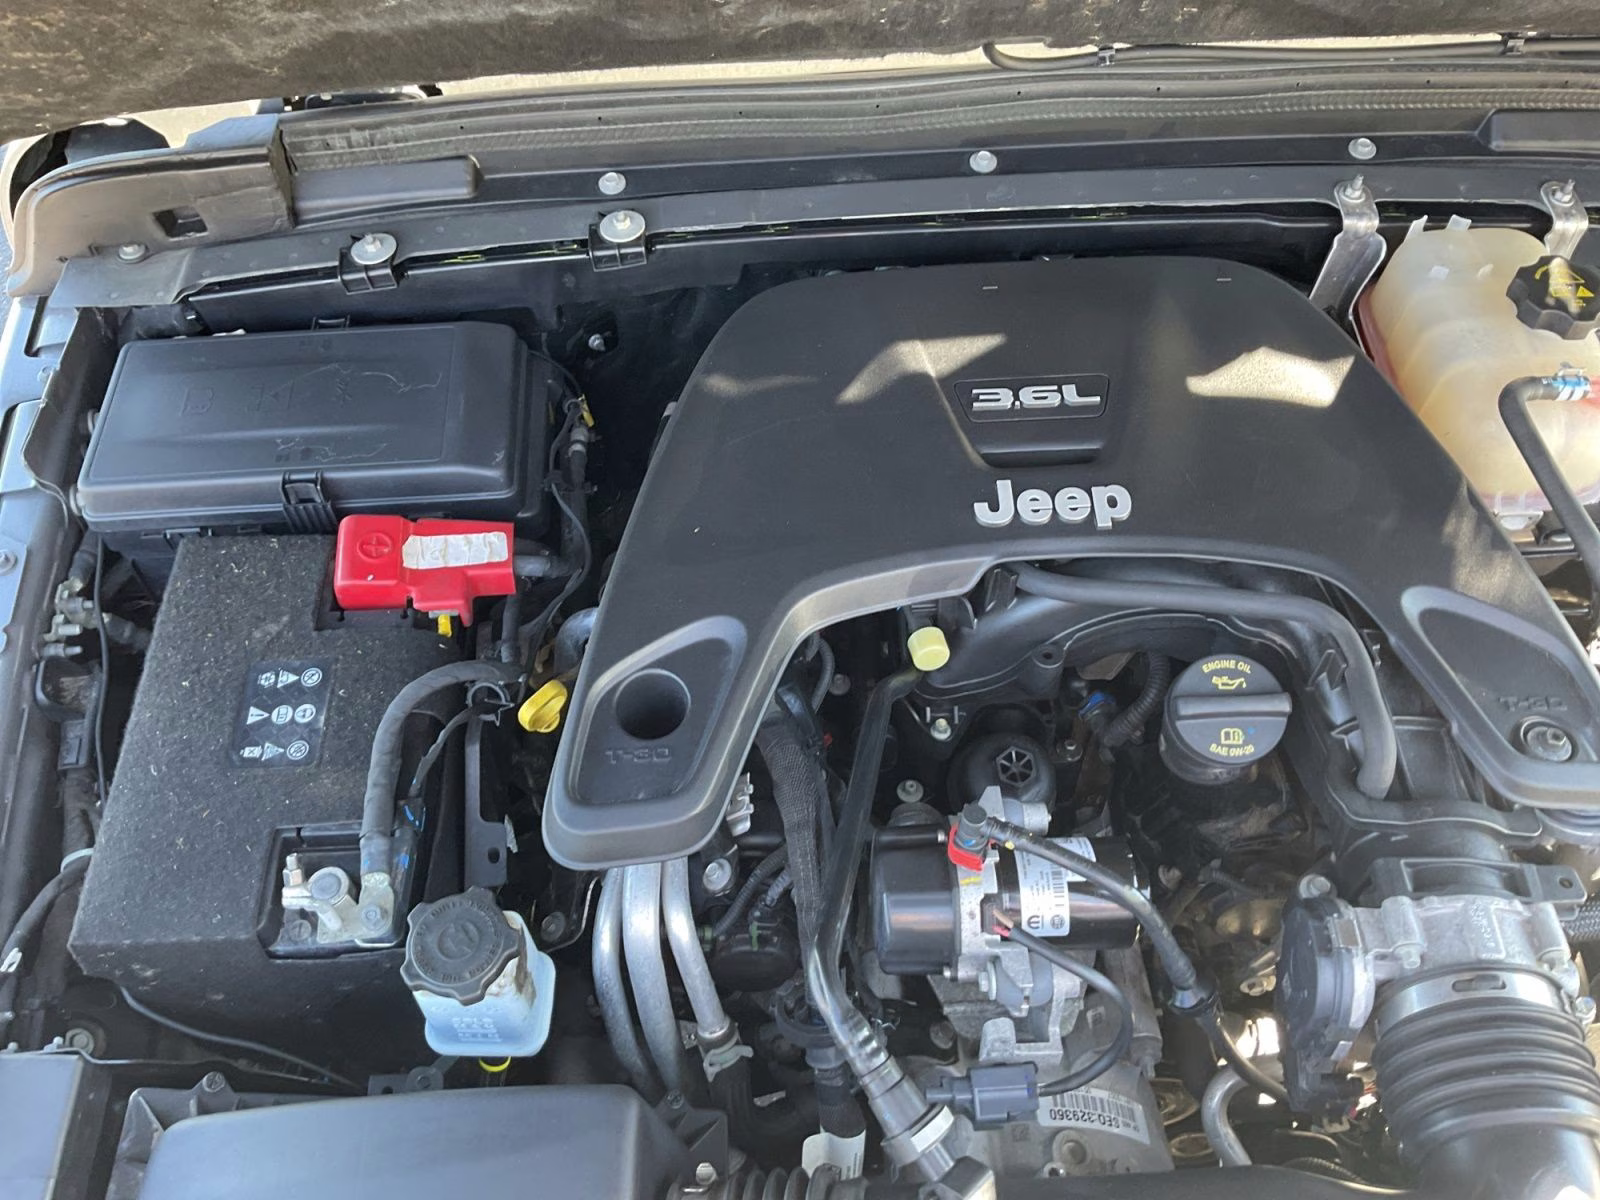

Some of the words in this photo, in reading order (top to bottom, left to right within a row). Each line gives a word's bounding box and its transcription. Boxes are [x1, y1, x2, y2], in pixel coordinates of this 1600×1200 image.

[972, 384, 1101, 411] 3.6L
[973, 479, 1132, 530] Jeep
[1202, 659, 1236, 673] ENGINE
[1237, 661, 1251, 674] OIL
